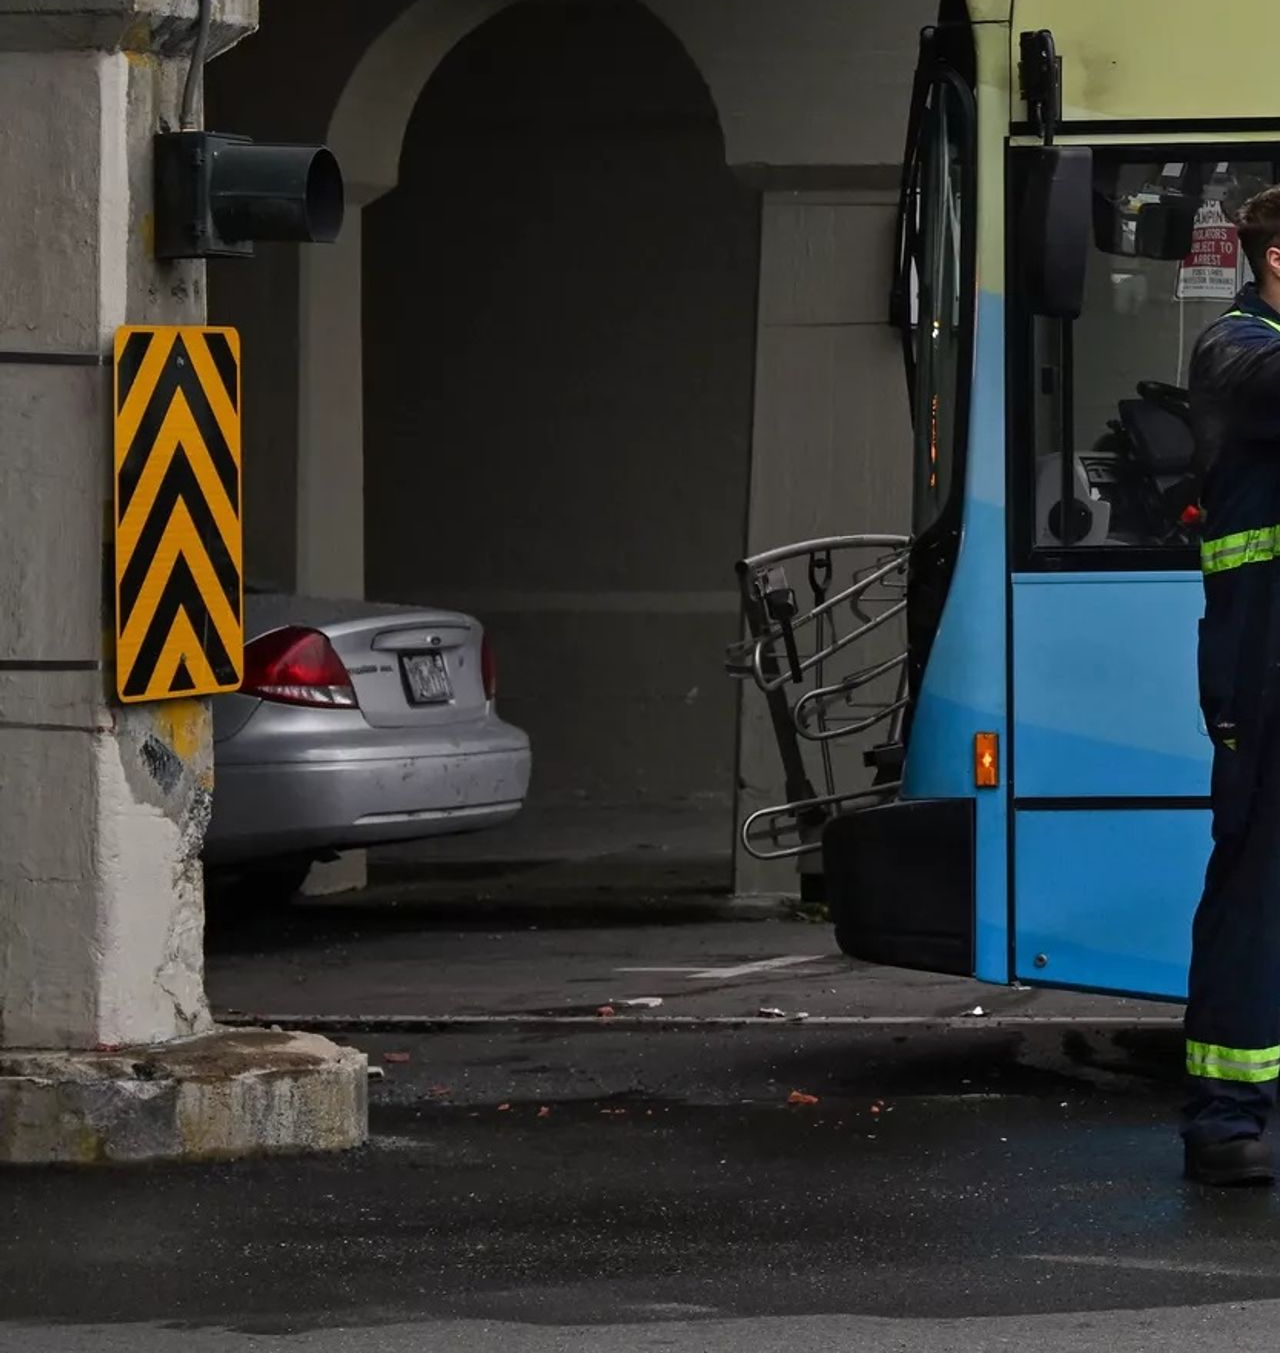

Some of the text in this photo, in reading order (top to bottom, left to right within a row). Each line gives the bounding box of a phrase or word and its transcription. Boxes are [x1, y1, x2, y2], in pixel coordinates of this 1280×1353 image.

[1191, 241, 1233, 254] UBJECT TO
[1192, 254, 1222, 266] ARREST
